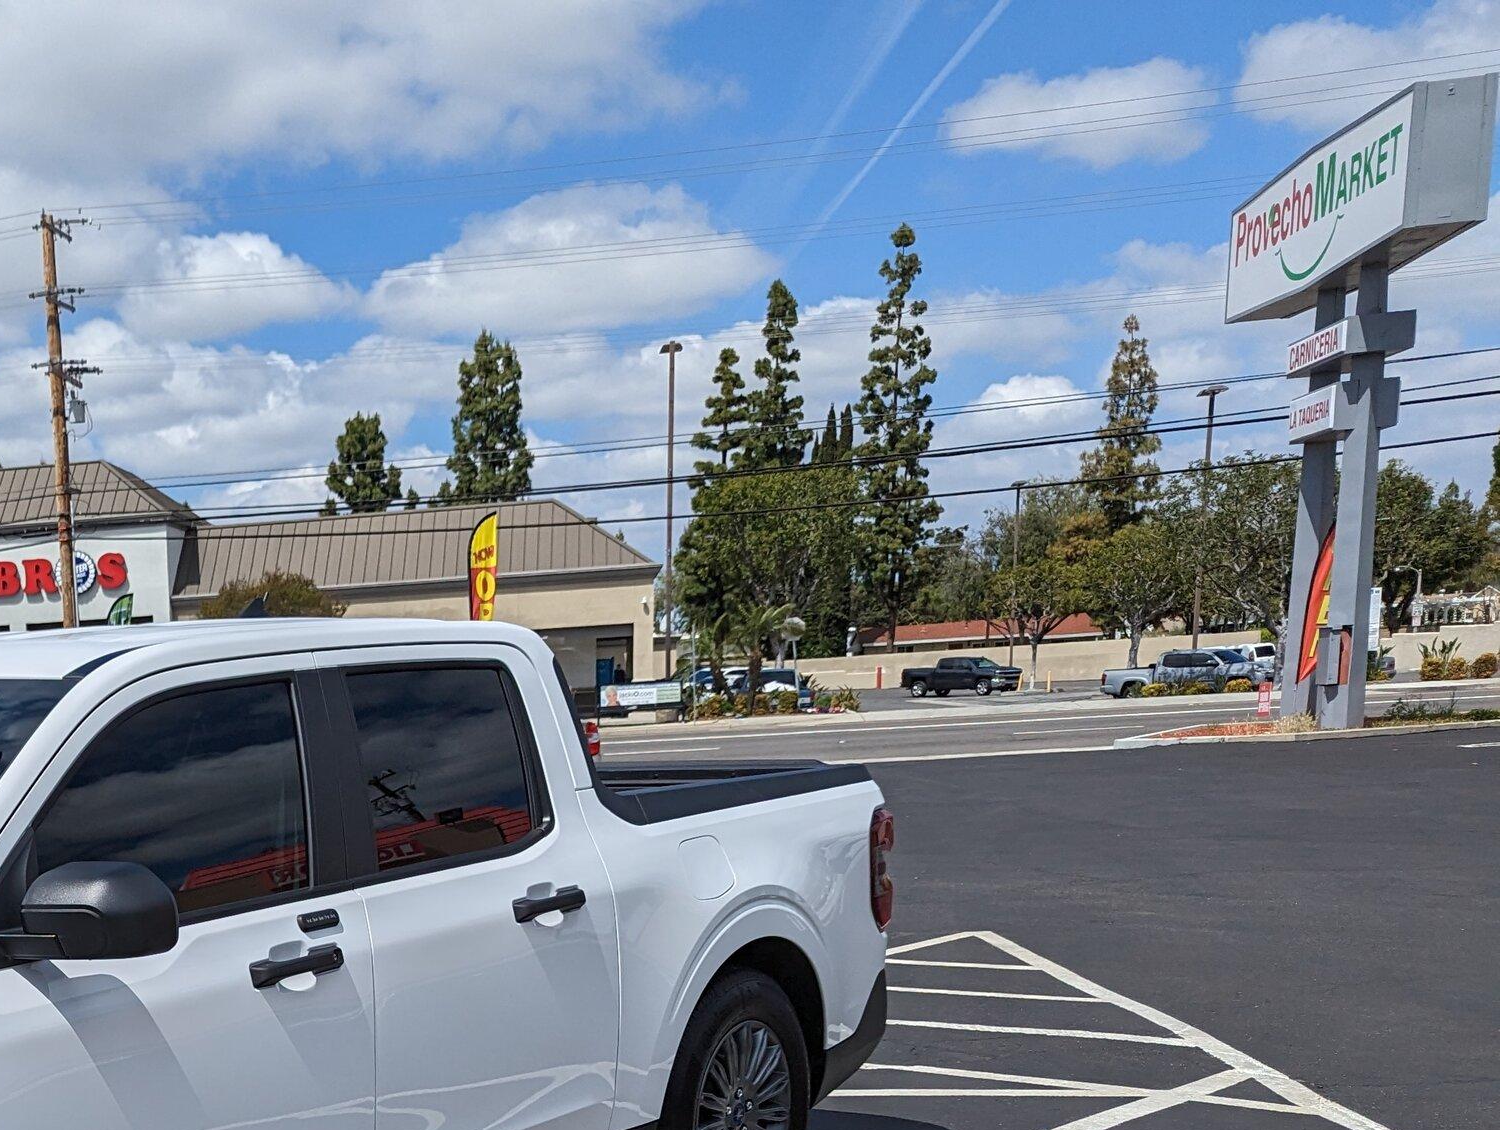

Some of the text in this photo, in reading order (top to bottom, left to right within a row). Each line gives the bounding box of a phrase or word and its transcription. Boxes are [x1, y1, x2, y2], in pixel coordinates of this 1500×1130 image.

[1235, 122, 1403, 268] Provecho MARKET
[1288, 327, 1338, 371] CARNICERIA
[1289, 400, 1330, 430] LA TAQUERIA
